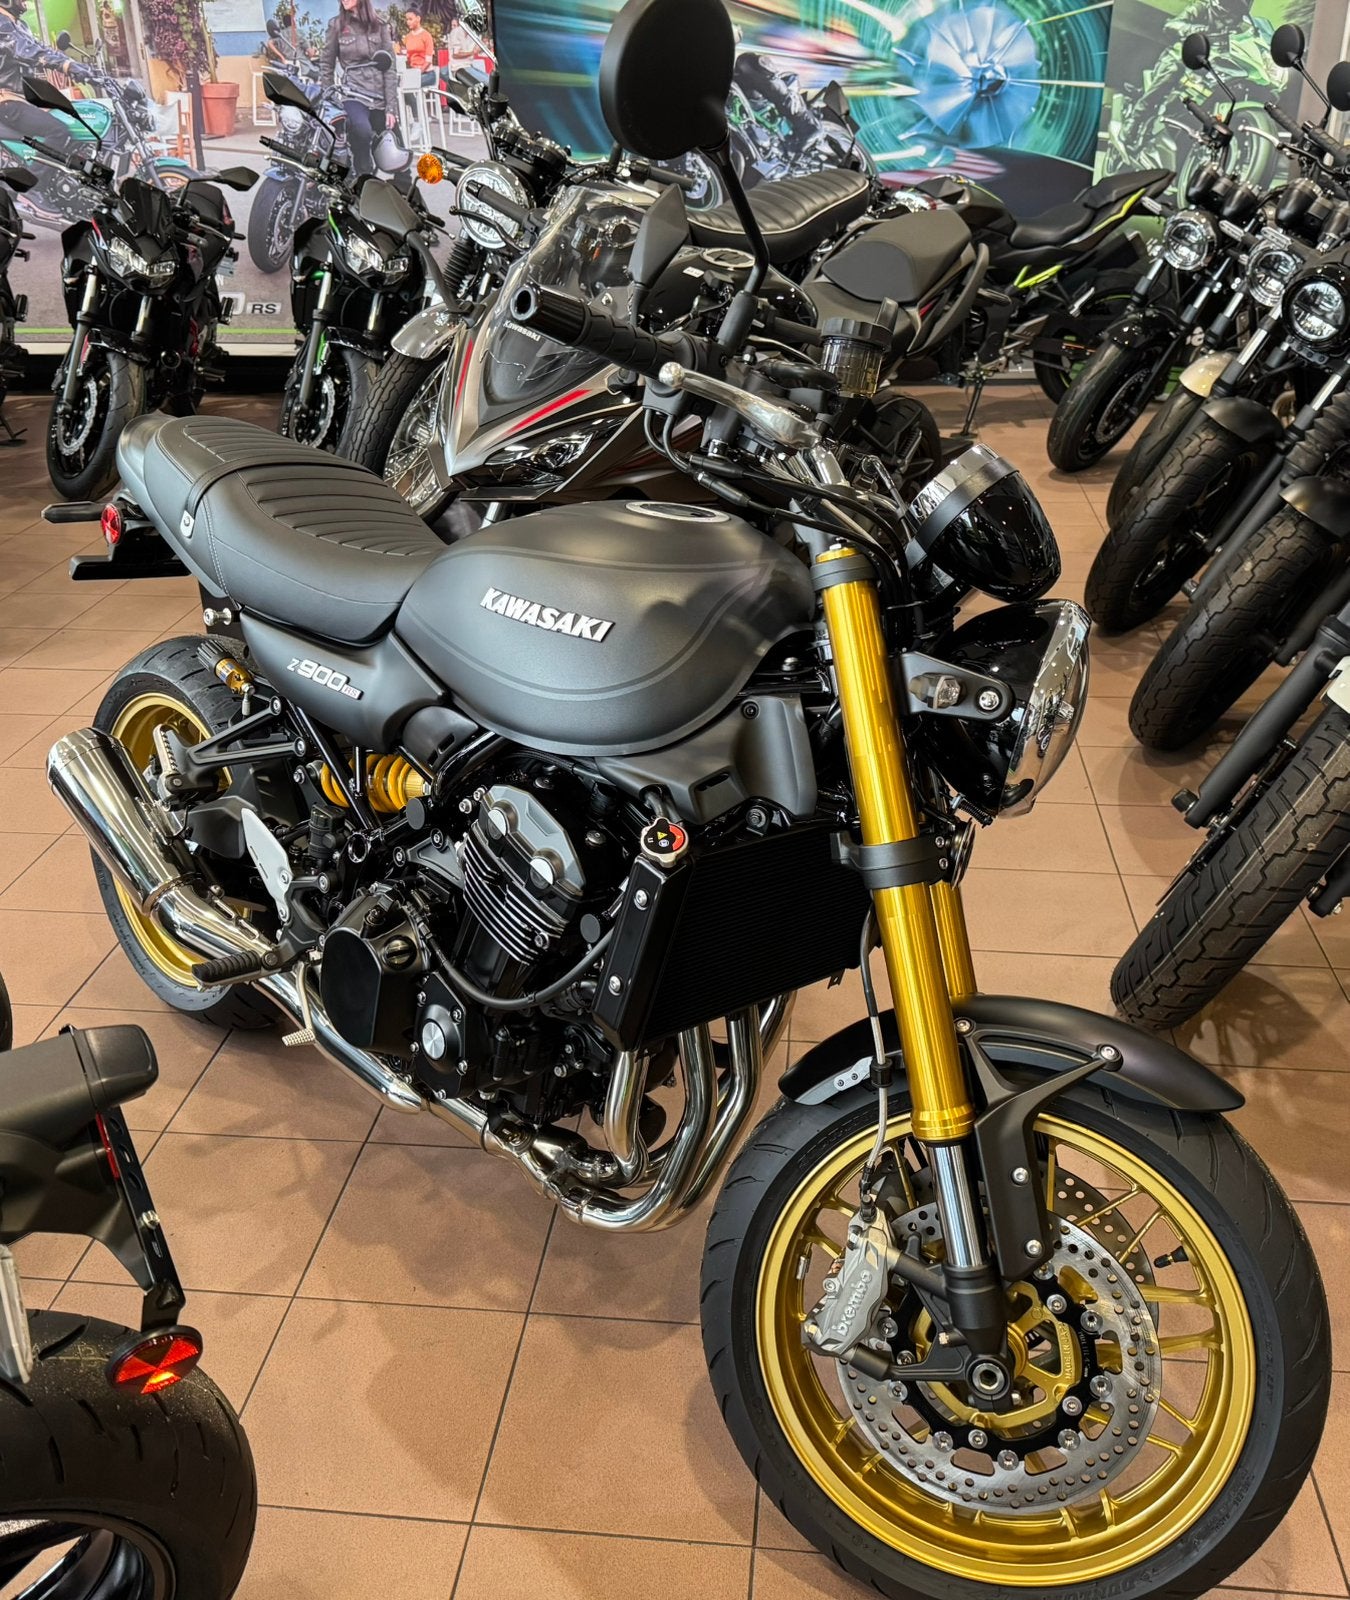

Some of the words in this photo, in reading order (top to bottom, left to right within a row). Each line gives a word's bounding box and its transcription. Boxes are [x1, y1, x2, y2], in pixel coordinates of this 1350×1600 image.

[251, 303, 277, 314] RS
[503, 320, 541, 341] Kawasaki
[480, 587, 615, 643] KAWASAKI
[832, 1270, 871, 1336] brembo
